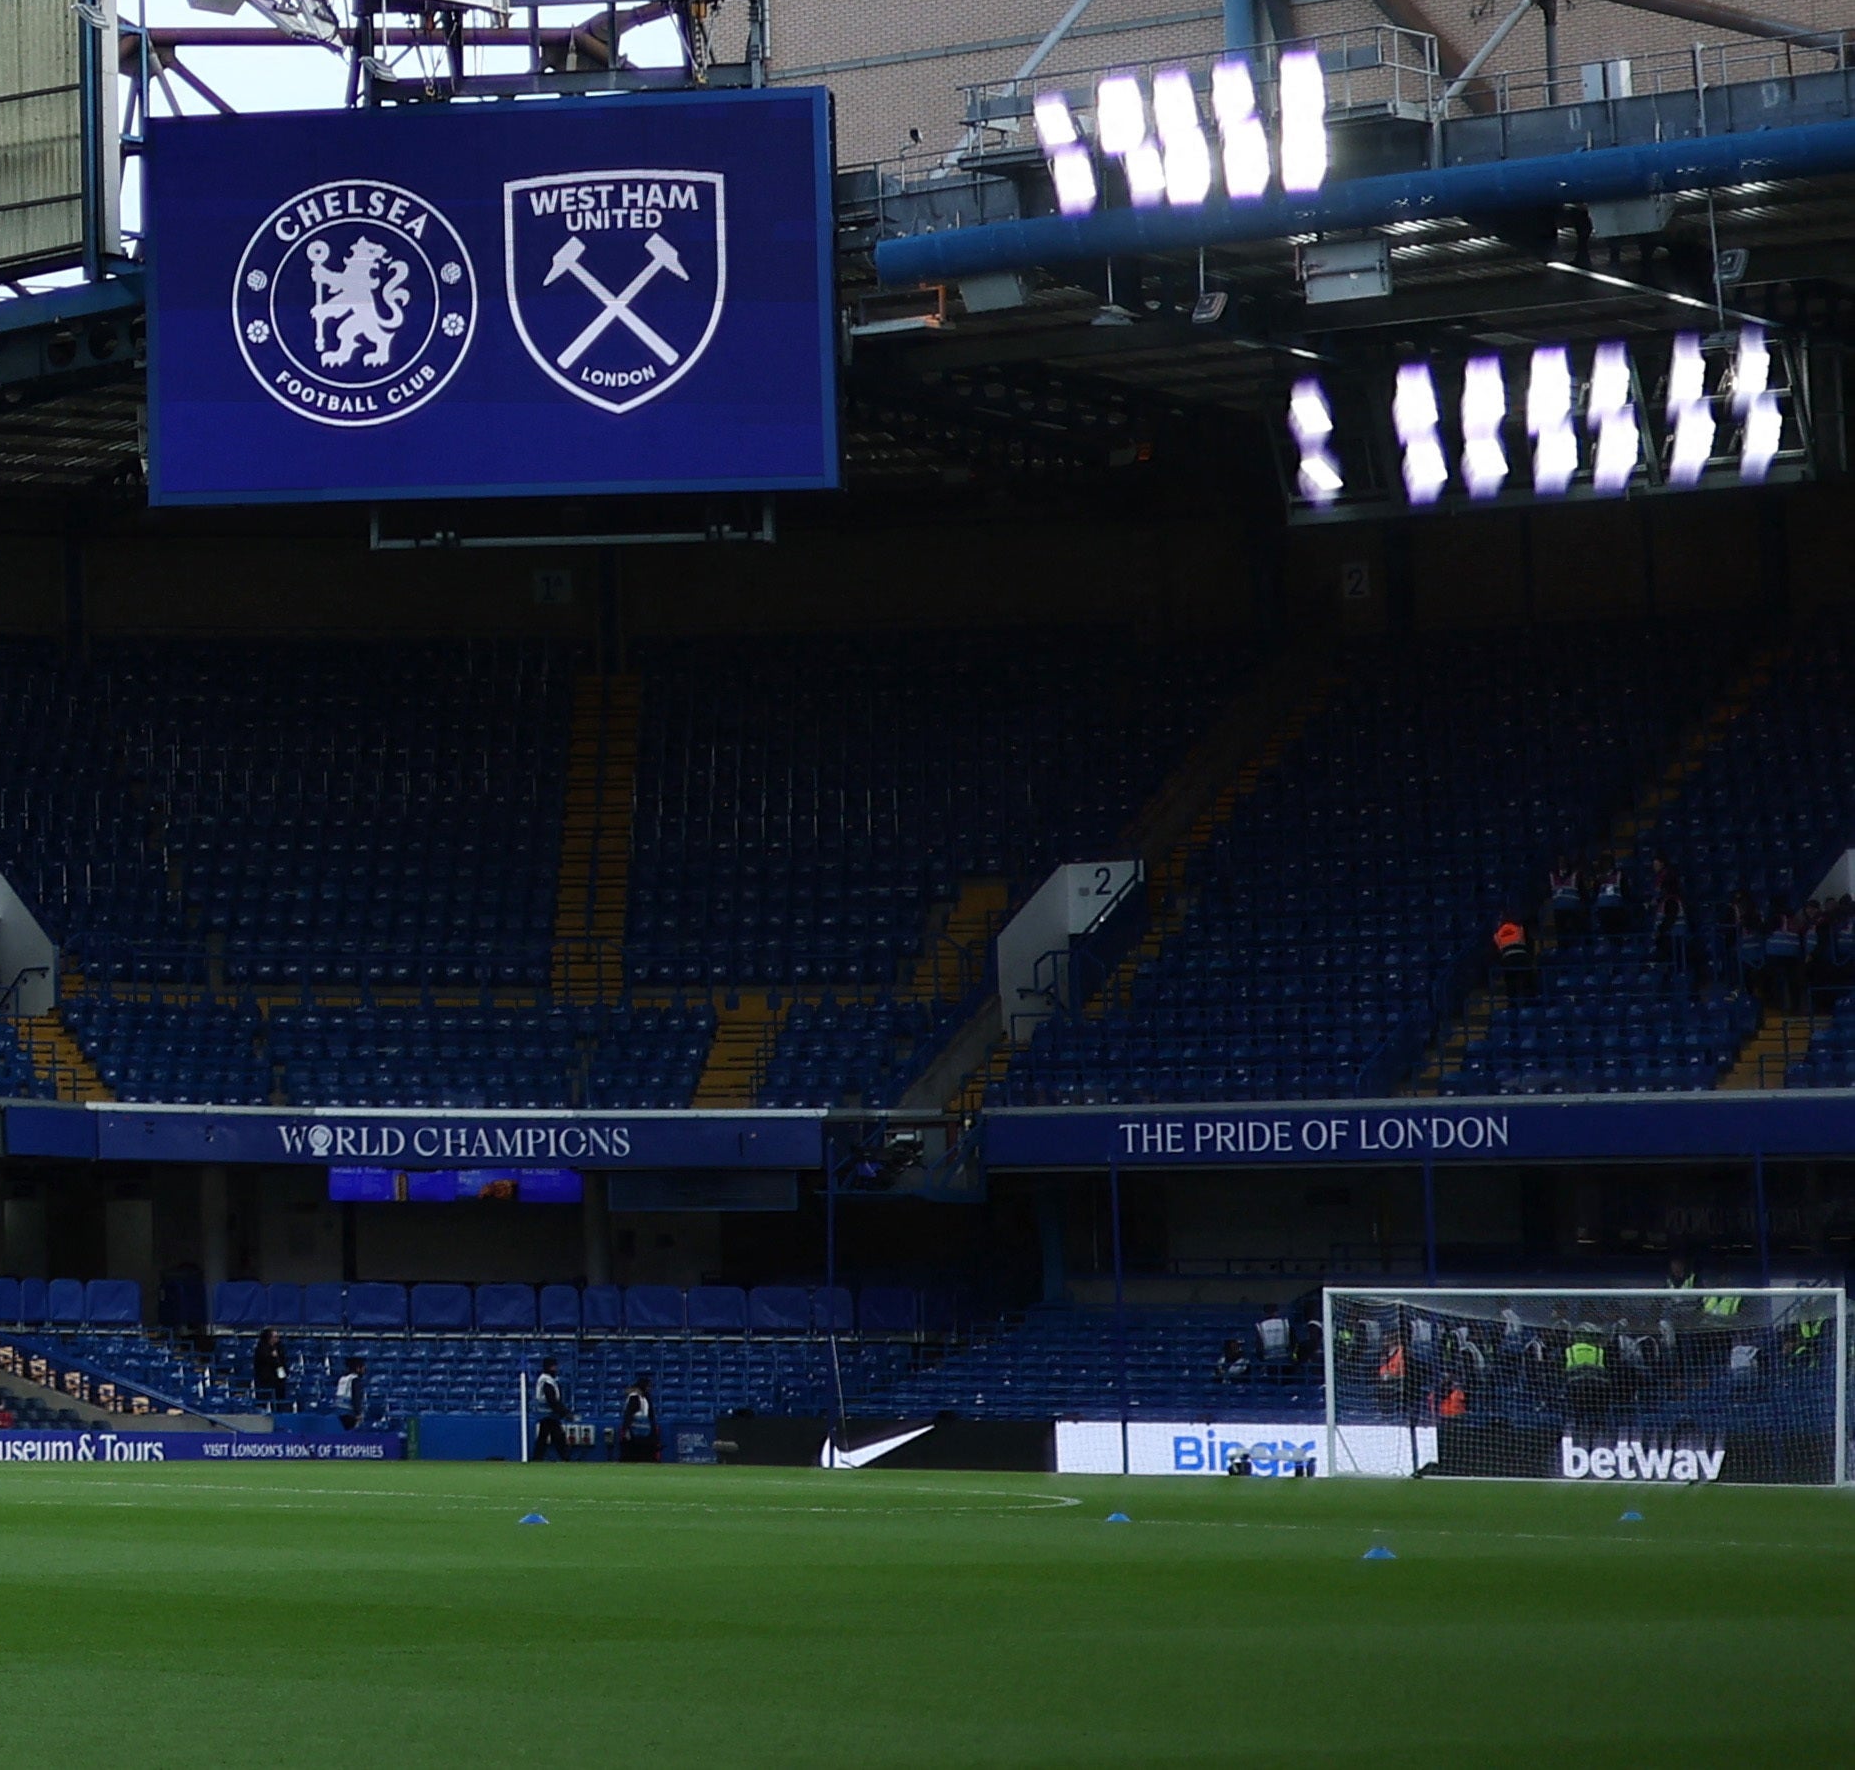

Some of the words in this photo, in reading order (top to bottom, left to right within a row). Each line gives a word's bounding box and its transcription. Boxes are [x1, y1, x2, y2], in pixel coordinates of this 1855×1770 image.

[529, 186, 615, 216] WEST
[621, 184, 698, 211] HAM
[275, 189, 430, 242] CHELSEA
[566, 209, 662, 231] UNITED
[275, 370, 379, 413] FOOTBALL
[386, 363, 436, 405] CLUB
[581, 364, 657, 388] LONDON
[1095, 867, 1112, 895] 2
[278, 1123, 405, 1158] WORLD
[414, 1125, 631, 1159] CHAMPIONS
[1119, 1122, 1184, 1154] THE
[1193, 1119, 1292, 1153] PRIDE
[1301, 1118, 1349, 1151] OF
[1359, 1115, 1509, 1150] LONDON
[77, 1433, 96, 1461] &
[98, 1434, 164, 1461] Tours
[202, 1443, 229, 1457] VISIT
[232, 1443, 283, 1457] LONDON'S
[317, 1444, 332, 1458] OF
[334, 1444, 384, 1459] TROPHIES
